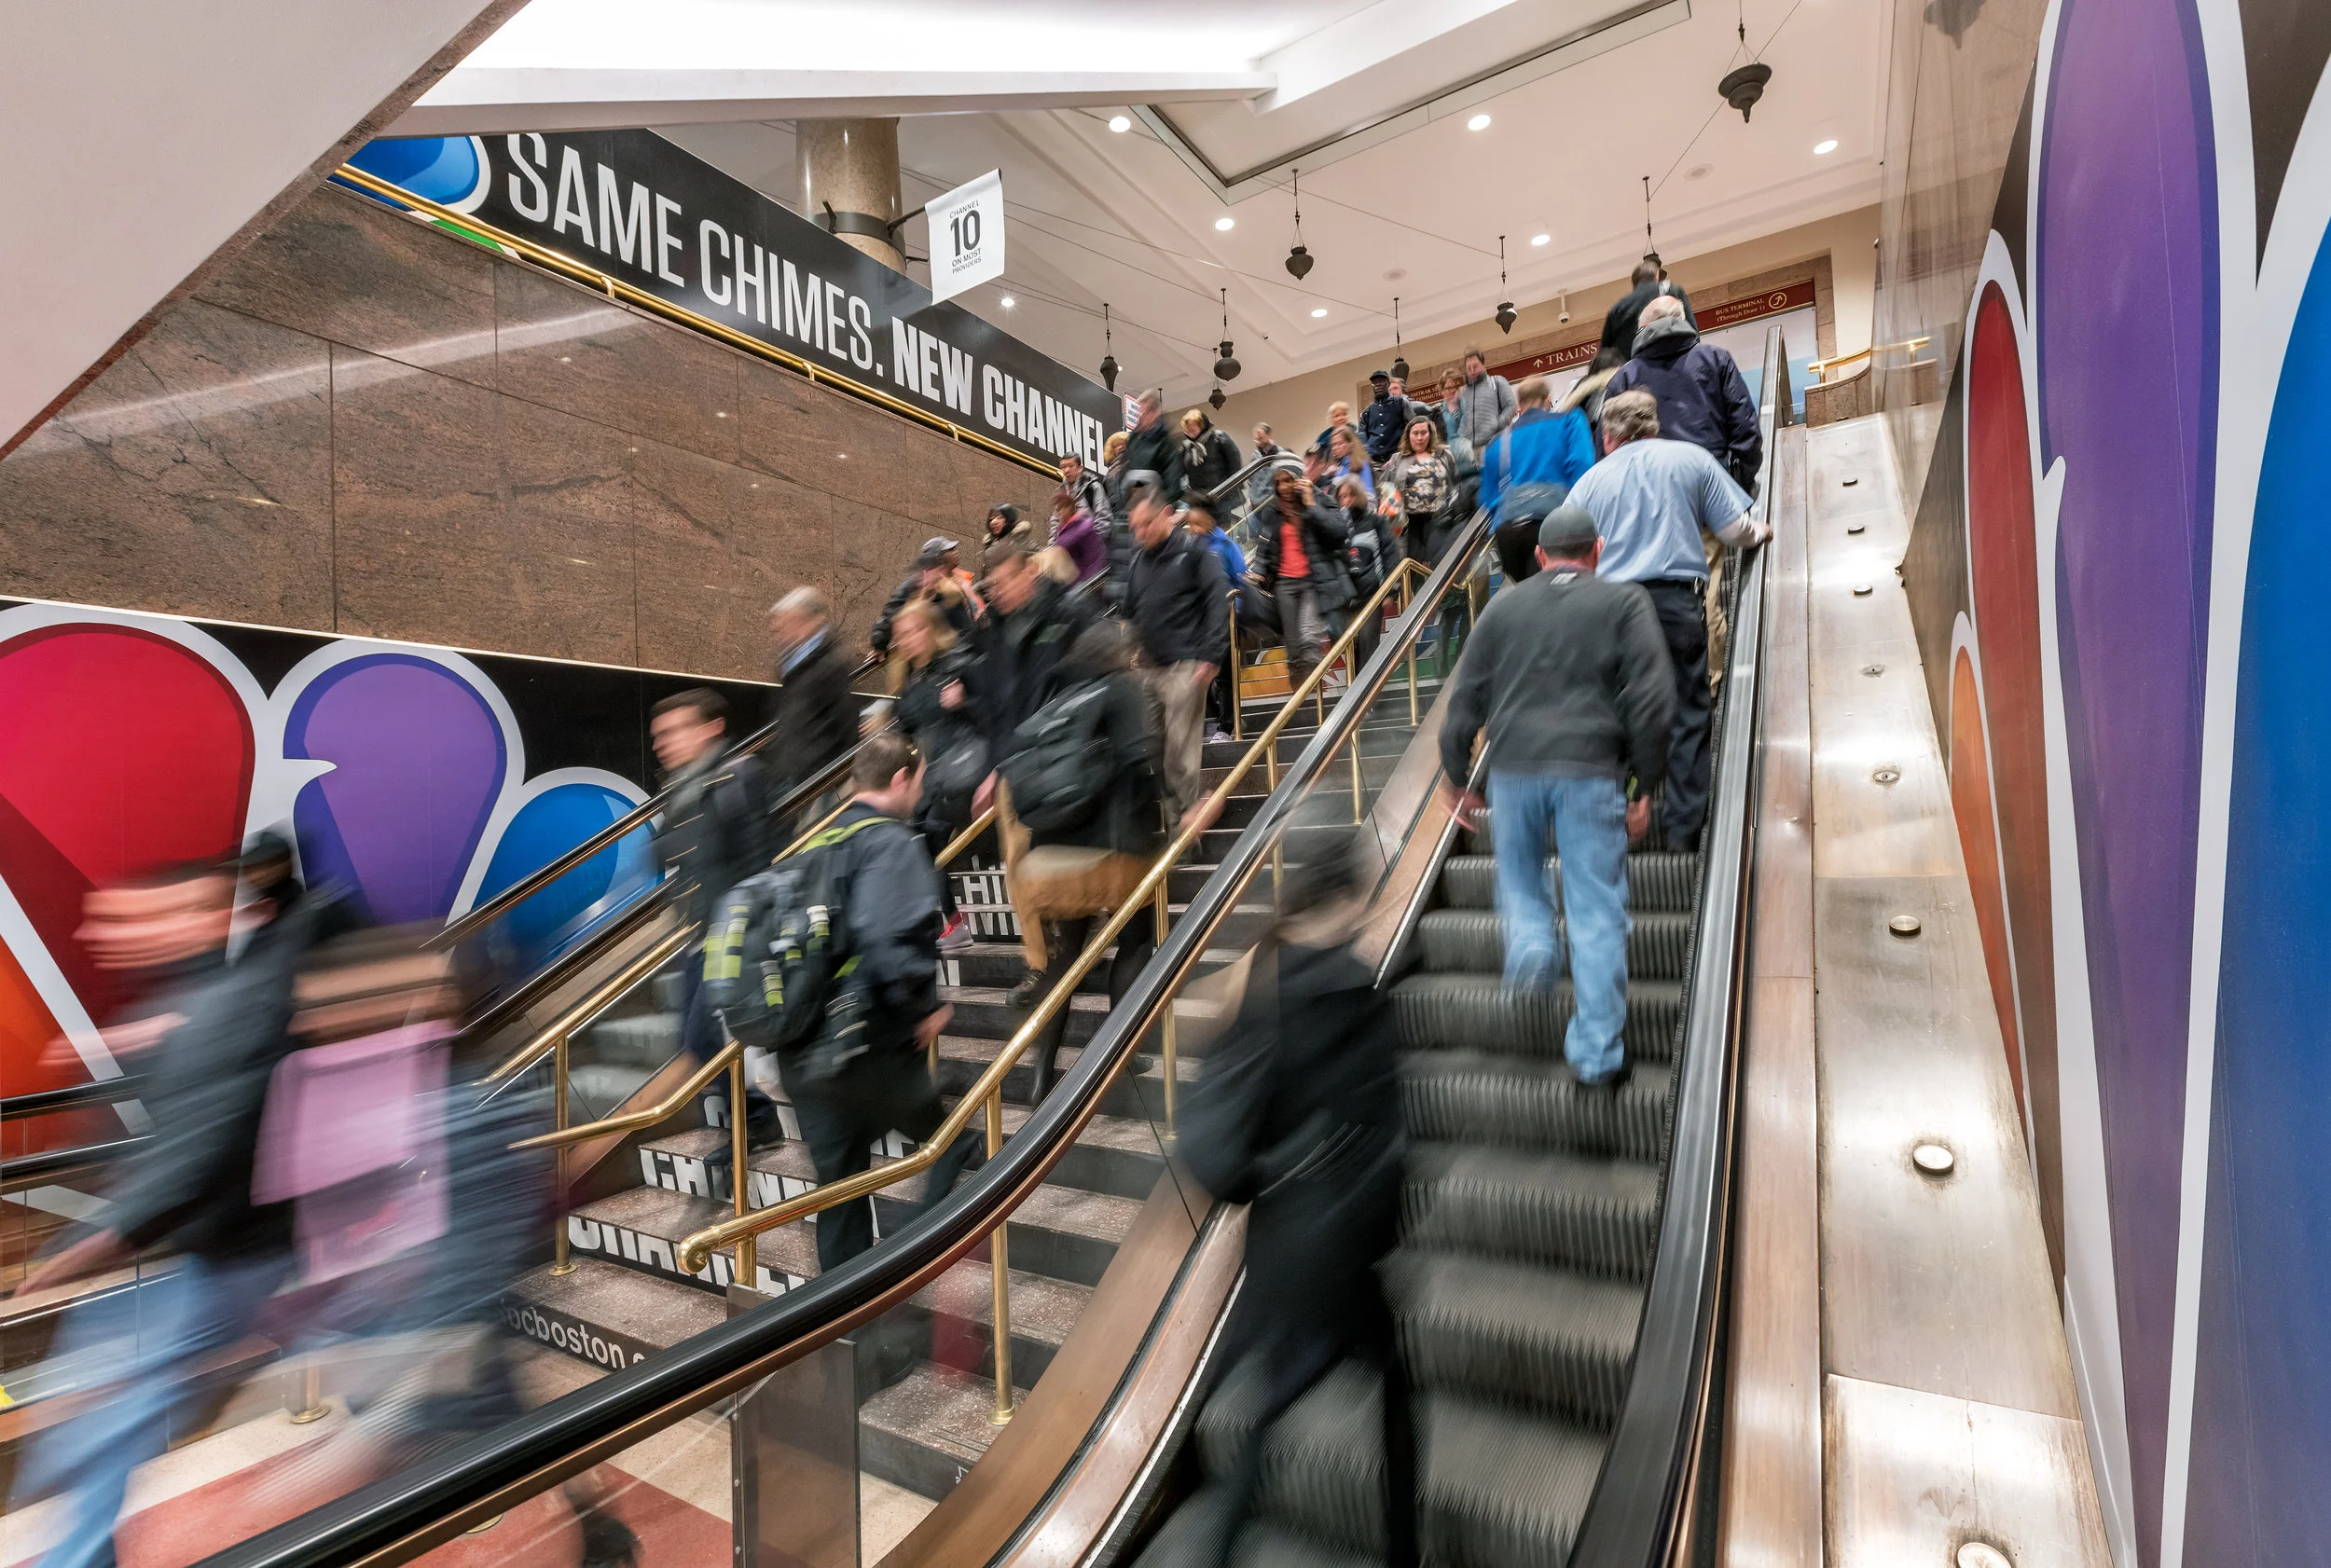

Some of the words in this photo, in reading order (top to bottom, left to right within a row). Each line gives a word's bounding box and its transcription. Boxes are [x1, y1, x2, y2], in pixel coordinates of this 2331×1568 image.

[949, 199, 980, 219] CHANNEL
[950, 210, 981, 257] 10
[952, 258, 962, 268] ON
[963, 248, 982, 261] MOST
[952, 256, 982, 274] PROVIDERS
[507, 133, 684, 288] SAME
[699, 219, 884, 377] CHIMES.
[891, 316, 973, 416] NEW
[982, 364, 1110, 477] CHANNEL
[1716, 307, 1729, 315] BUS
[1730, 298, 1764, 311] TERMINAL
[1744, 307, 1758, 315] Door
[1546, 343, 1597, 365] TRAINS
[501, 1298, 646, 1369] bcboston
